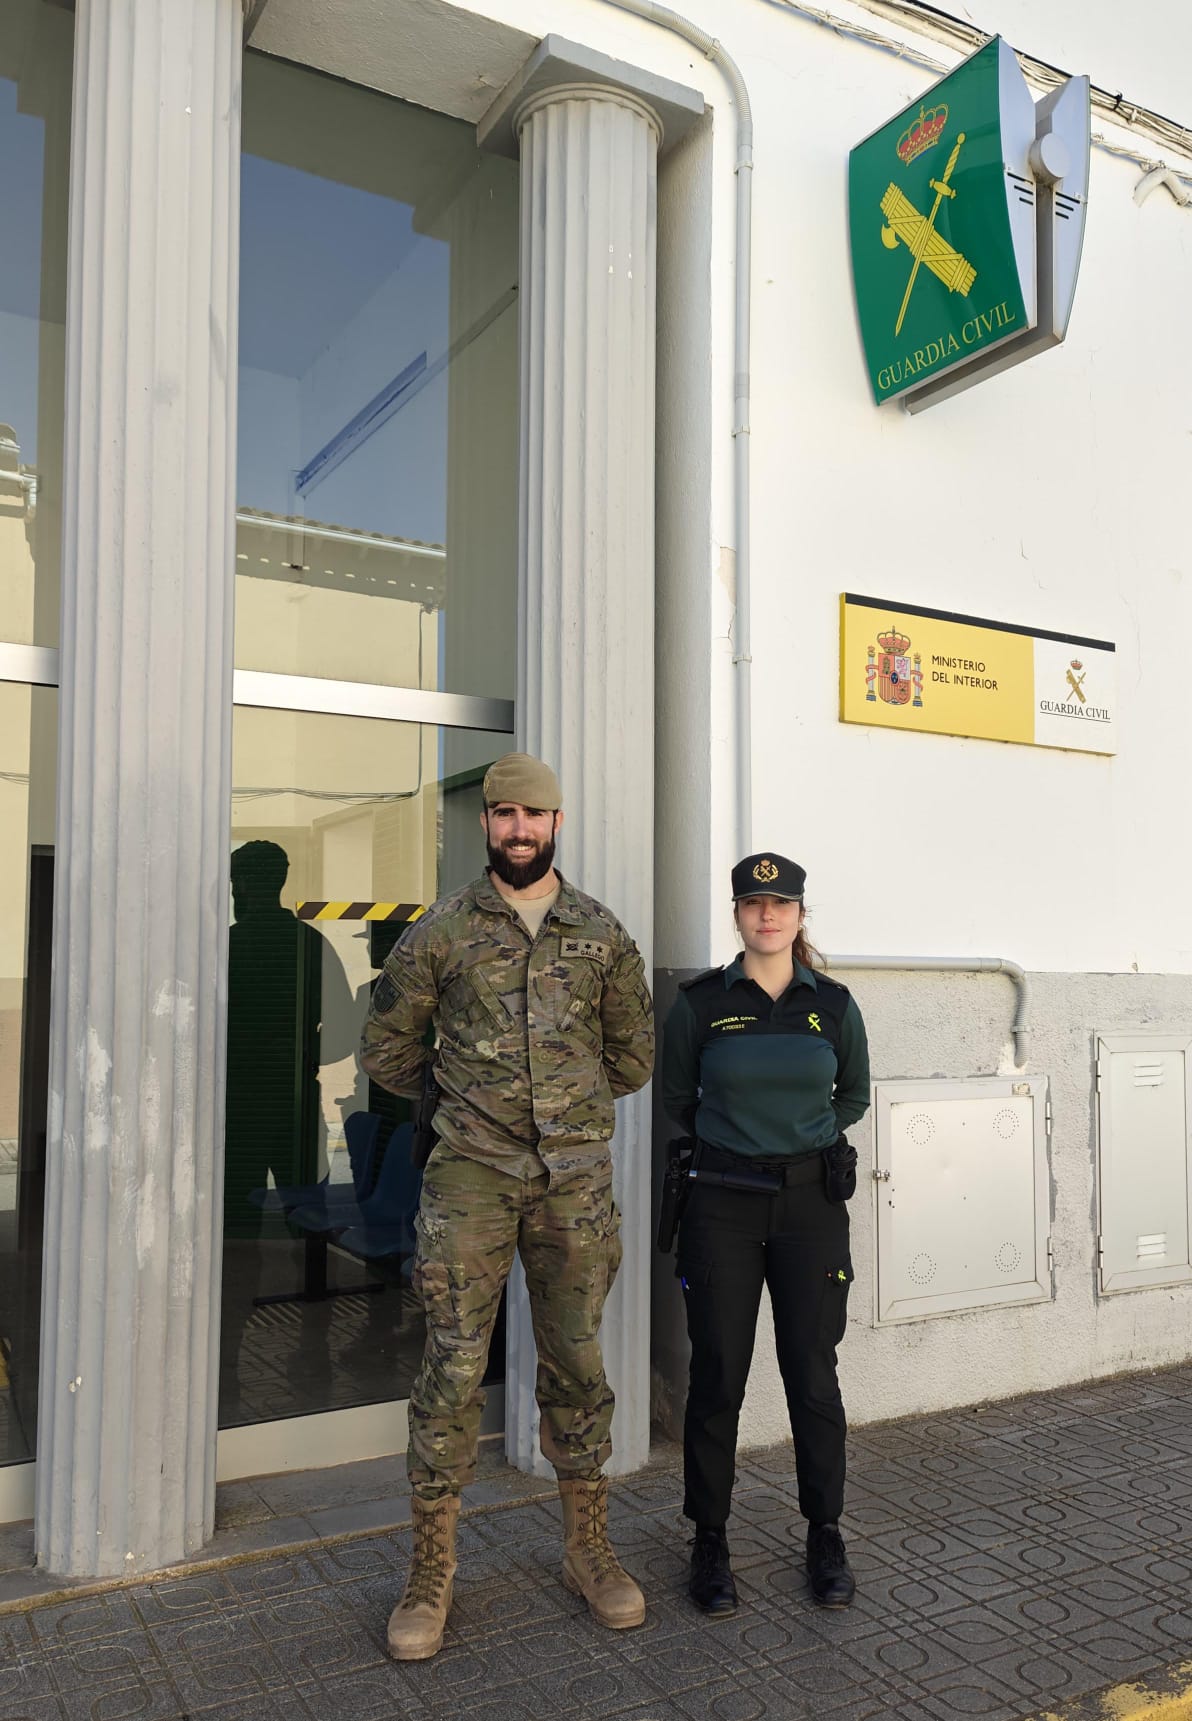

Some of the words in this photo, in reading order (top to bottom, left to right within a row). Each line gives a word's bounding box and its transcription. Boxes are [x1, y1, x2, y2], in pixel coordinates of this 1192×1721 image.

[877, 332, 960, 390] GUARDIA
[962, 301, 1016, 344] CIVIL
[931, 655, 986, 673] MINISTERIO
[931, 671, 950, 684] DEL
[953, 675, 998, 690] INTERIOR
[1040, 700, 1084, 716] GUARDIA
[1085, 707, 1111, 720] CIVIL
[580, 950, 605, 962] GALLEGO
[710, 1016, 739, 1028] GUARDIA
